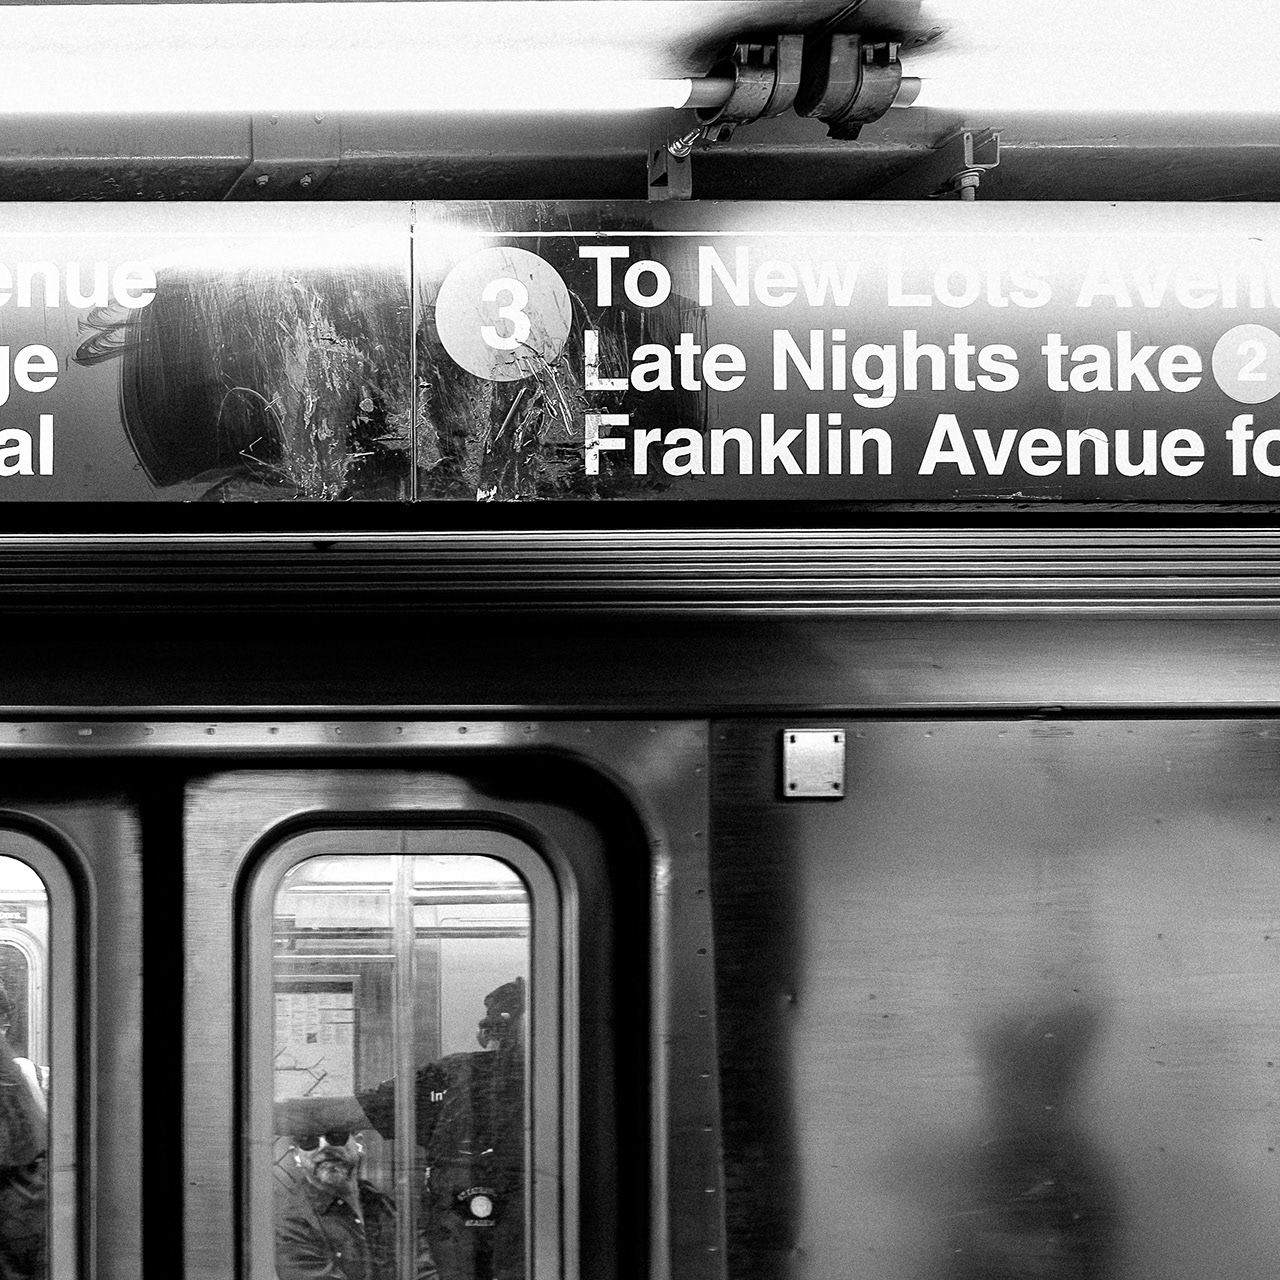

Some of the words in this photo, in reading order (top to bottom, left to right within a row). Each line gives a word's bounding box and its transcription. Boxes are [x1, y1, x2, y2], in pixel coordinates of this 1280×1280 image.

[578, 246, 671, 308] To
[698, 246, 865, 308] New
[886, 247, 1051, 309] Lots
[1076, 247, 1280, 309] Aven
[480, 278, 530, 350] 3
[583, 330, 746, 393] Late
[773, 330, 1019, 408] Nights
[1041, 330, 1202, 393] take
[1237, 339, 1267, 382] 2
[583, 413, 891, 476] Franklin
[920, 414, 1206, 477] Avenue
